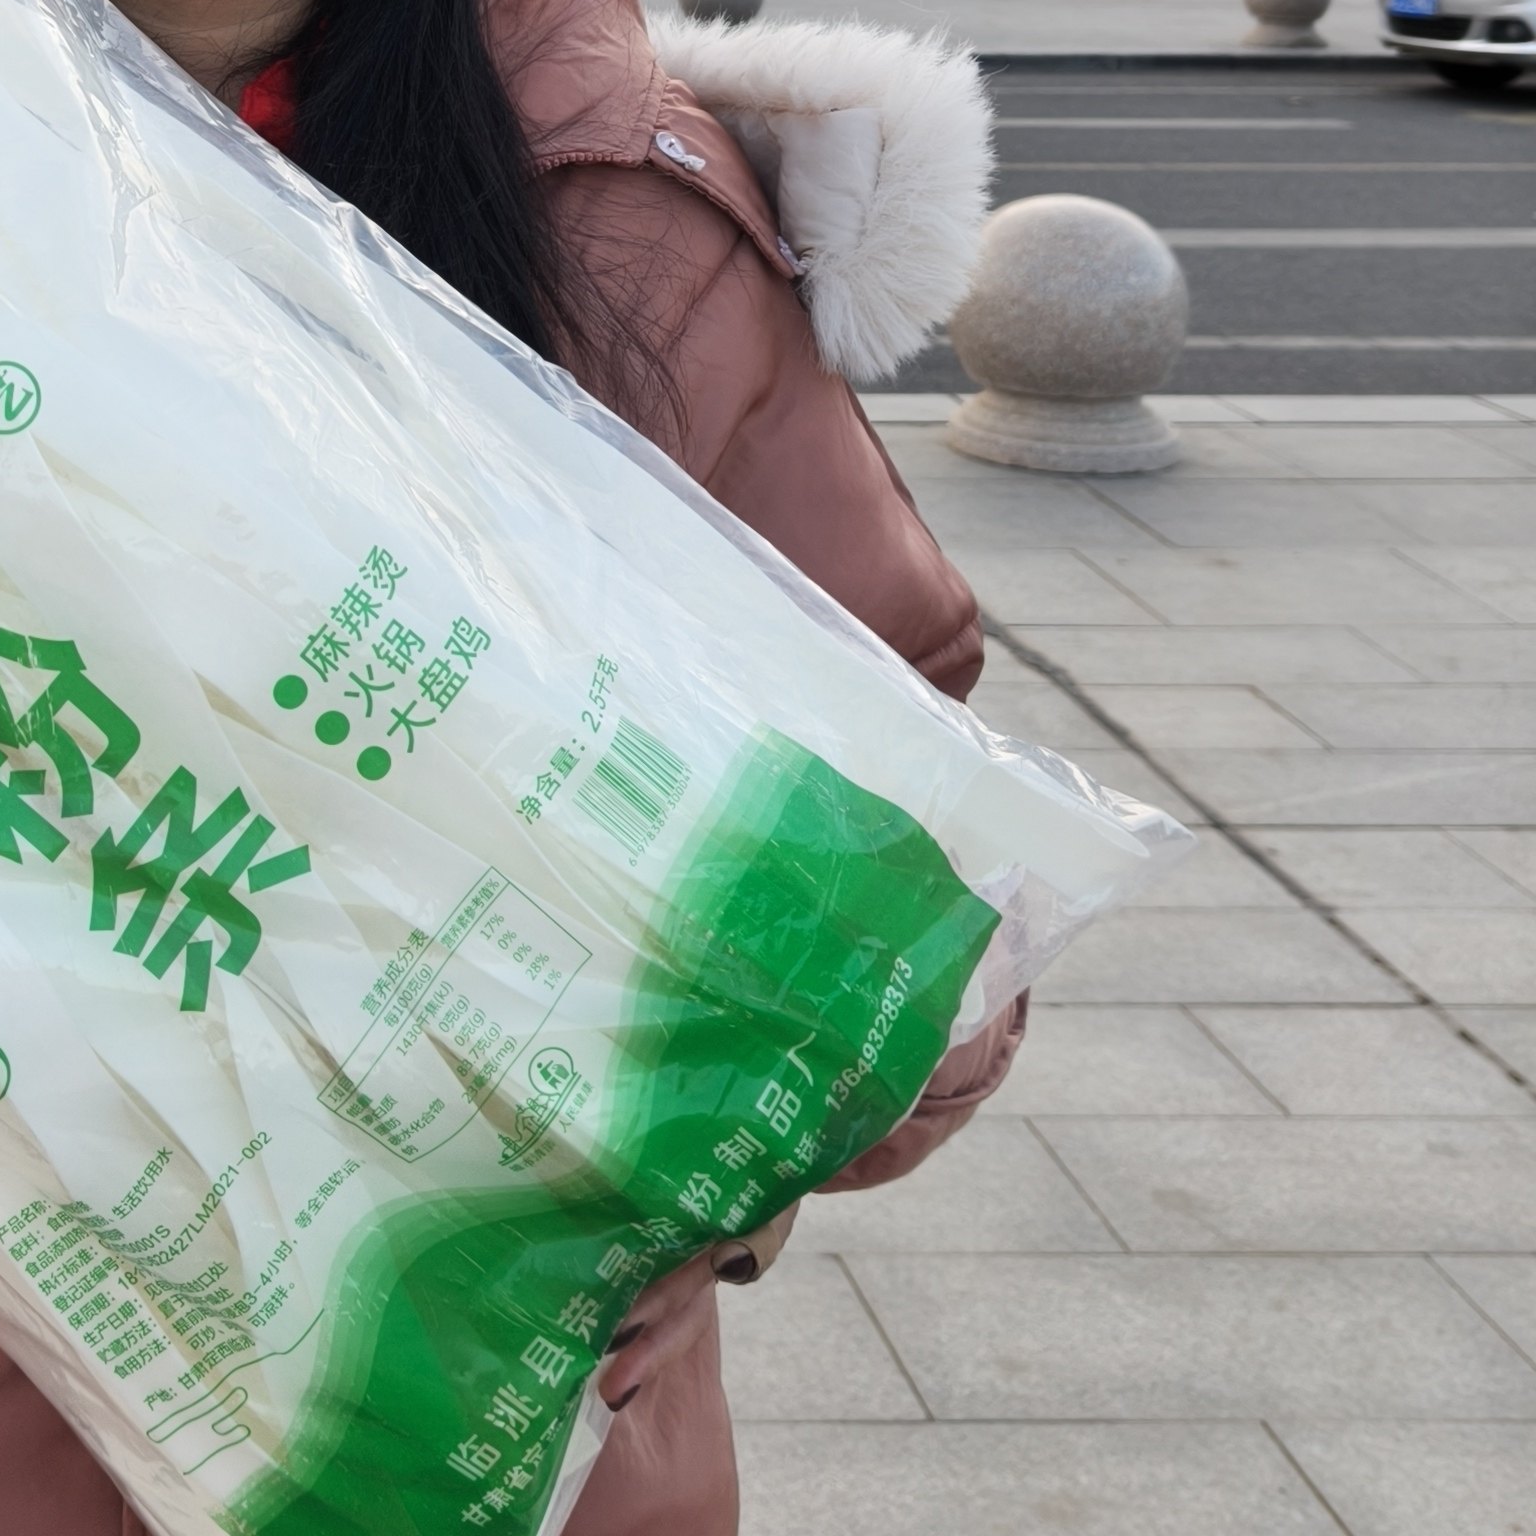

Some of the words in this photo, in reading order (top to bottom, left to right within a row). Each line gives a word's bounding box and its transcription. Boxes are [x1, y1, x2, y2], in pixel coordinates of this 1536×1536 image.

[300, 544, 408, 682] 麻辣烫
[343, 618, 426, 718] 火锅
[386, 616, 492, 754] 大盘鸡
[440, 878, 500, 950] 营养素参考值%
[480, 913, 505, 941] 17%
[497, 930, 517, 951] 0%
[360, 927, 429, 1016] 营养成分表
[512, 944, 532, 964] 0%
[525, 952, 550, 982] 28%
[544, 969, 562, 991] 1%
[824, 956, 913, 1111] 13649328373
